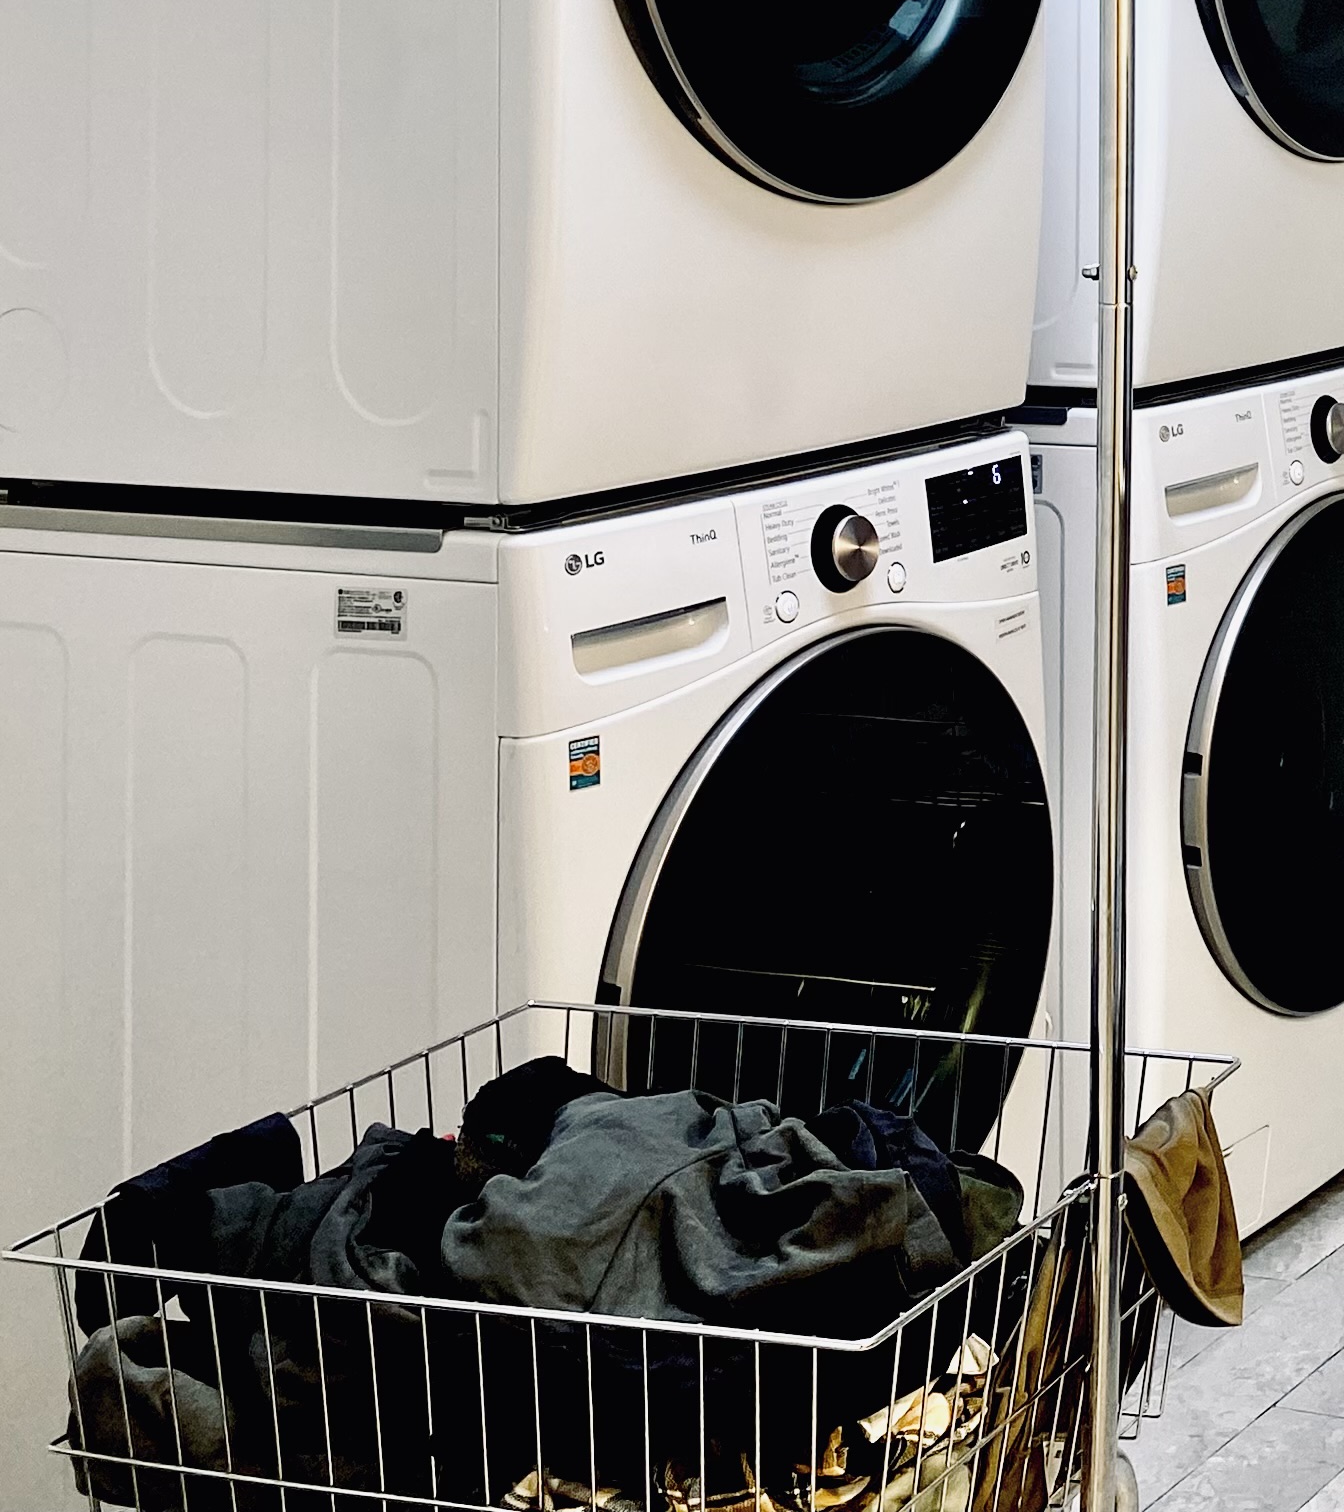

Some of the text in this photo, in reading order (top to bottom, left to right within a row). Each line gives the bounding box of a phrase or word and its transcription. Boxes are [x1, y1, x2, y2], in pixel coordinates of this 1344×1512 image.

[1171, 423, 1184, 437] LG
[992, 463, 1001, 484] 6
[690, 529, 718, 545] ThinQ
[585, 551, 605, 569] LG
